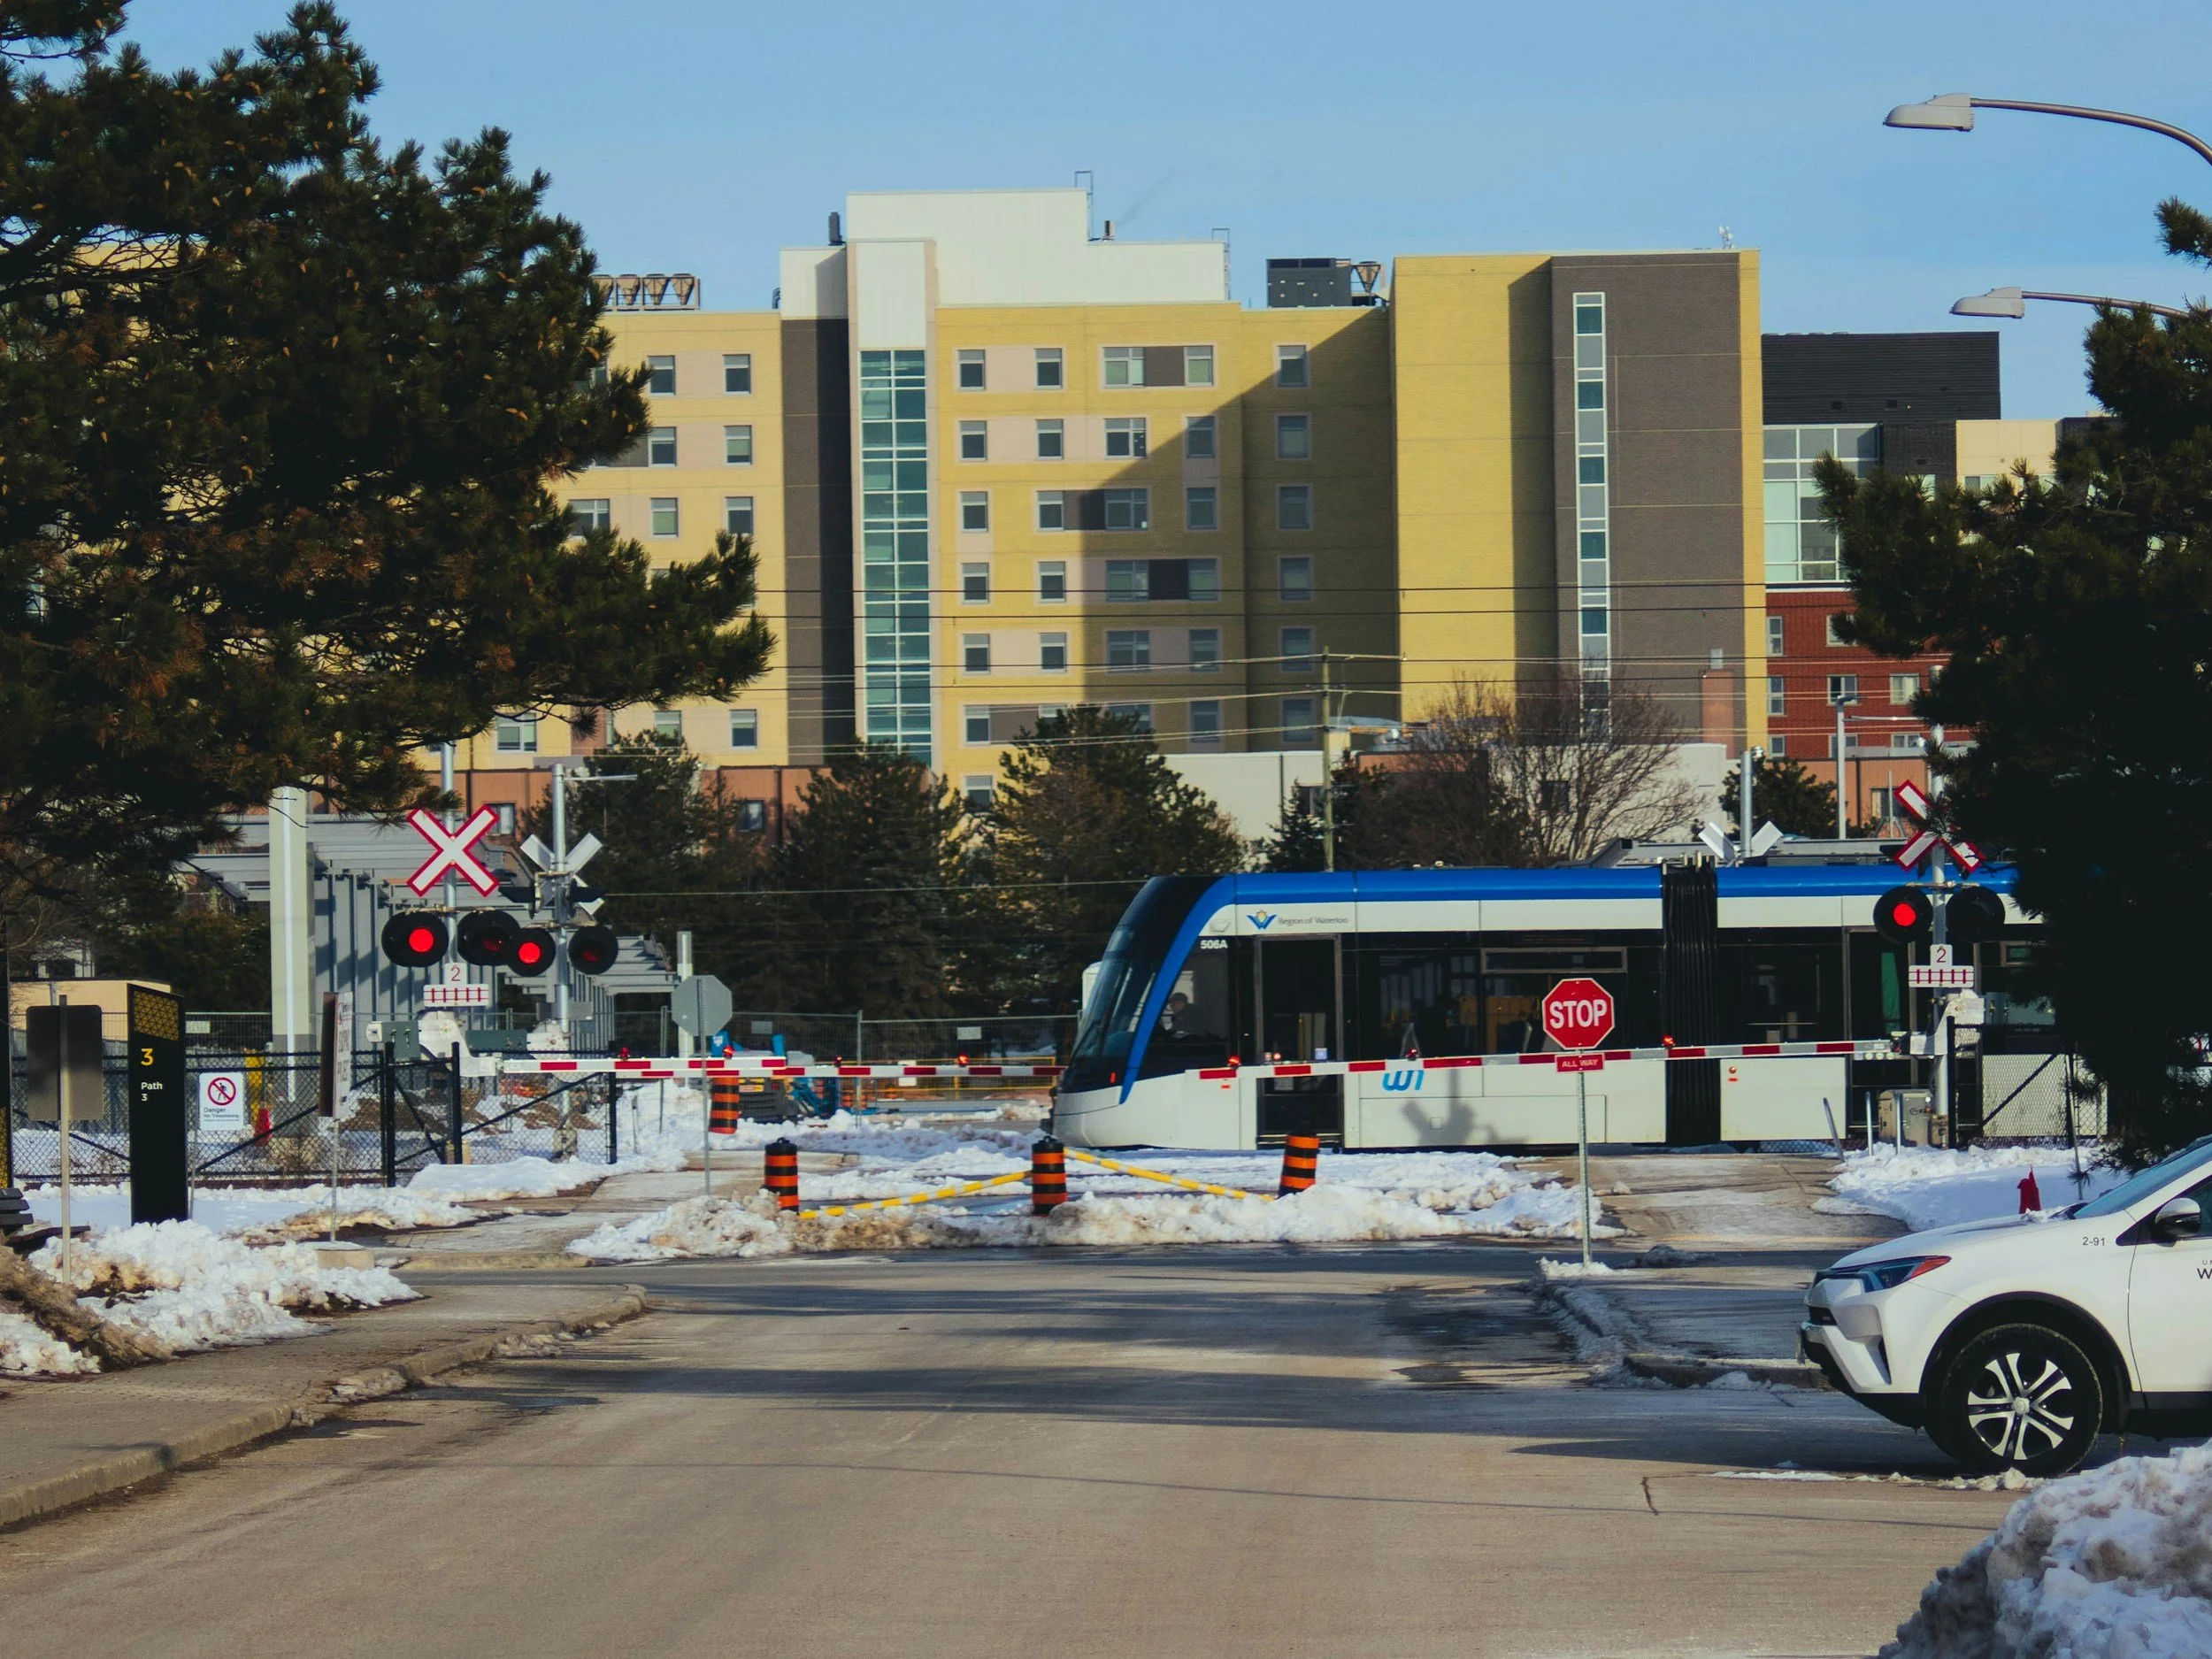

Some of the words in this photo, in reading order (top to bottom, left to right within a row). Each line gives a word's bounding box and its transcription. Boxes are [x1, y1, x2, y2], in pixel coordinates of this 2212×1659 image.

[1279, 917, 1303, 926] Region
[1200, 940, 1228, 949] 506A
[1936, 948, 1947, 963] 2
[450, 966, 461, 981] 2
[1549, 999, 1608, 1029] STOP
[141, 1048, 154, 1066] 3
[141, 1081, 163, 1090] Path
[2082, 1236, 2106, 1247] 2-91
